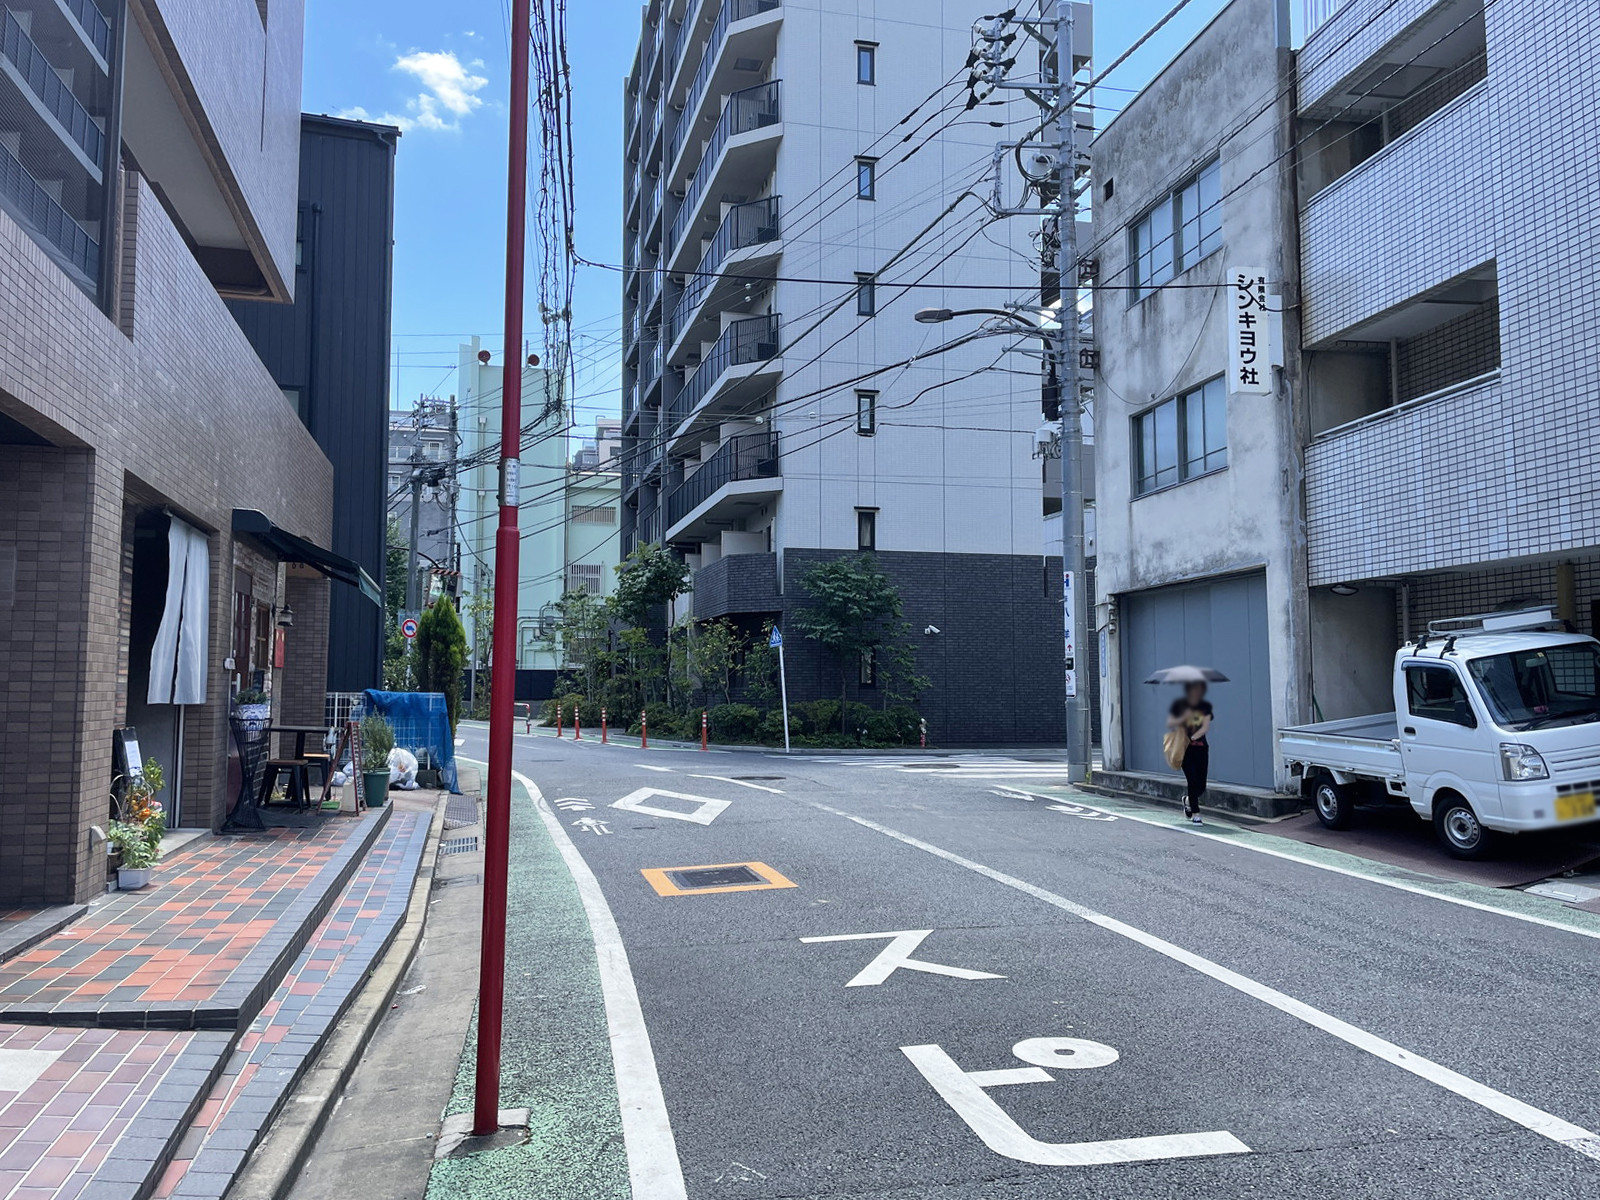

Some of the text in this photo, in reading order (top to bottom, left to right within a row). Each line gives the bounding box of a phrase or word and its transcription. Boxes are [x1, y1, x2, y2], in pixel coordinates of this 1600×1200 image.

[1238, 274, 1259, 385] シンキヨウ社
